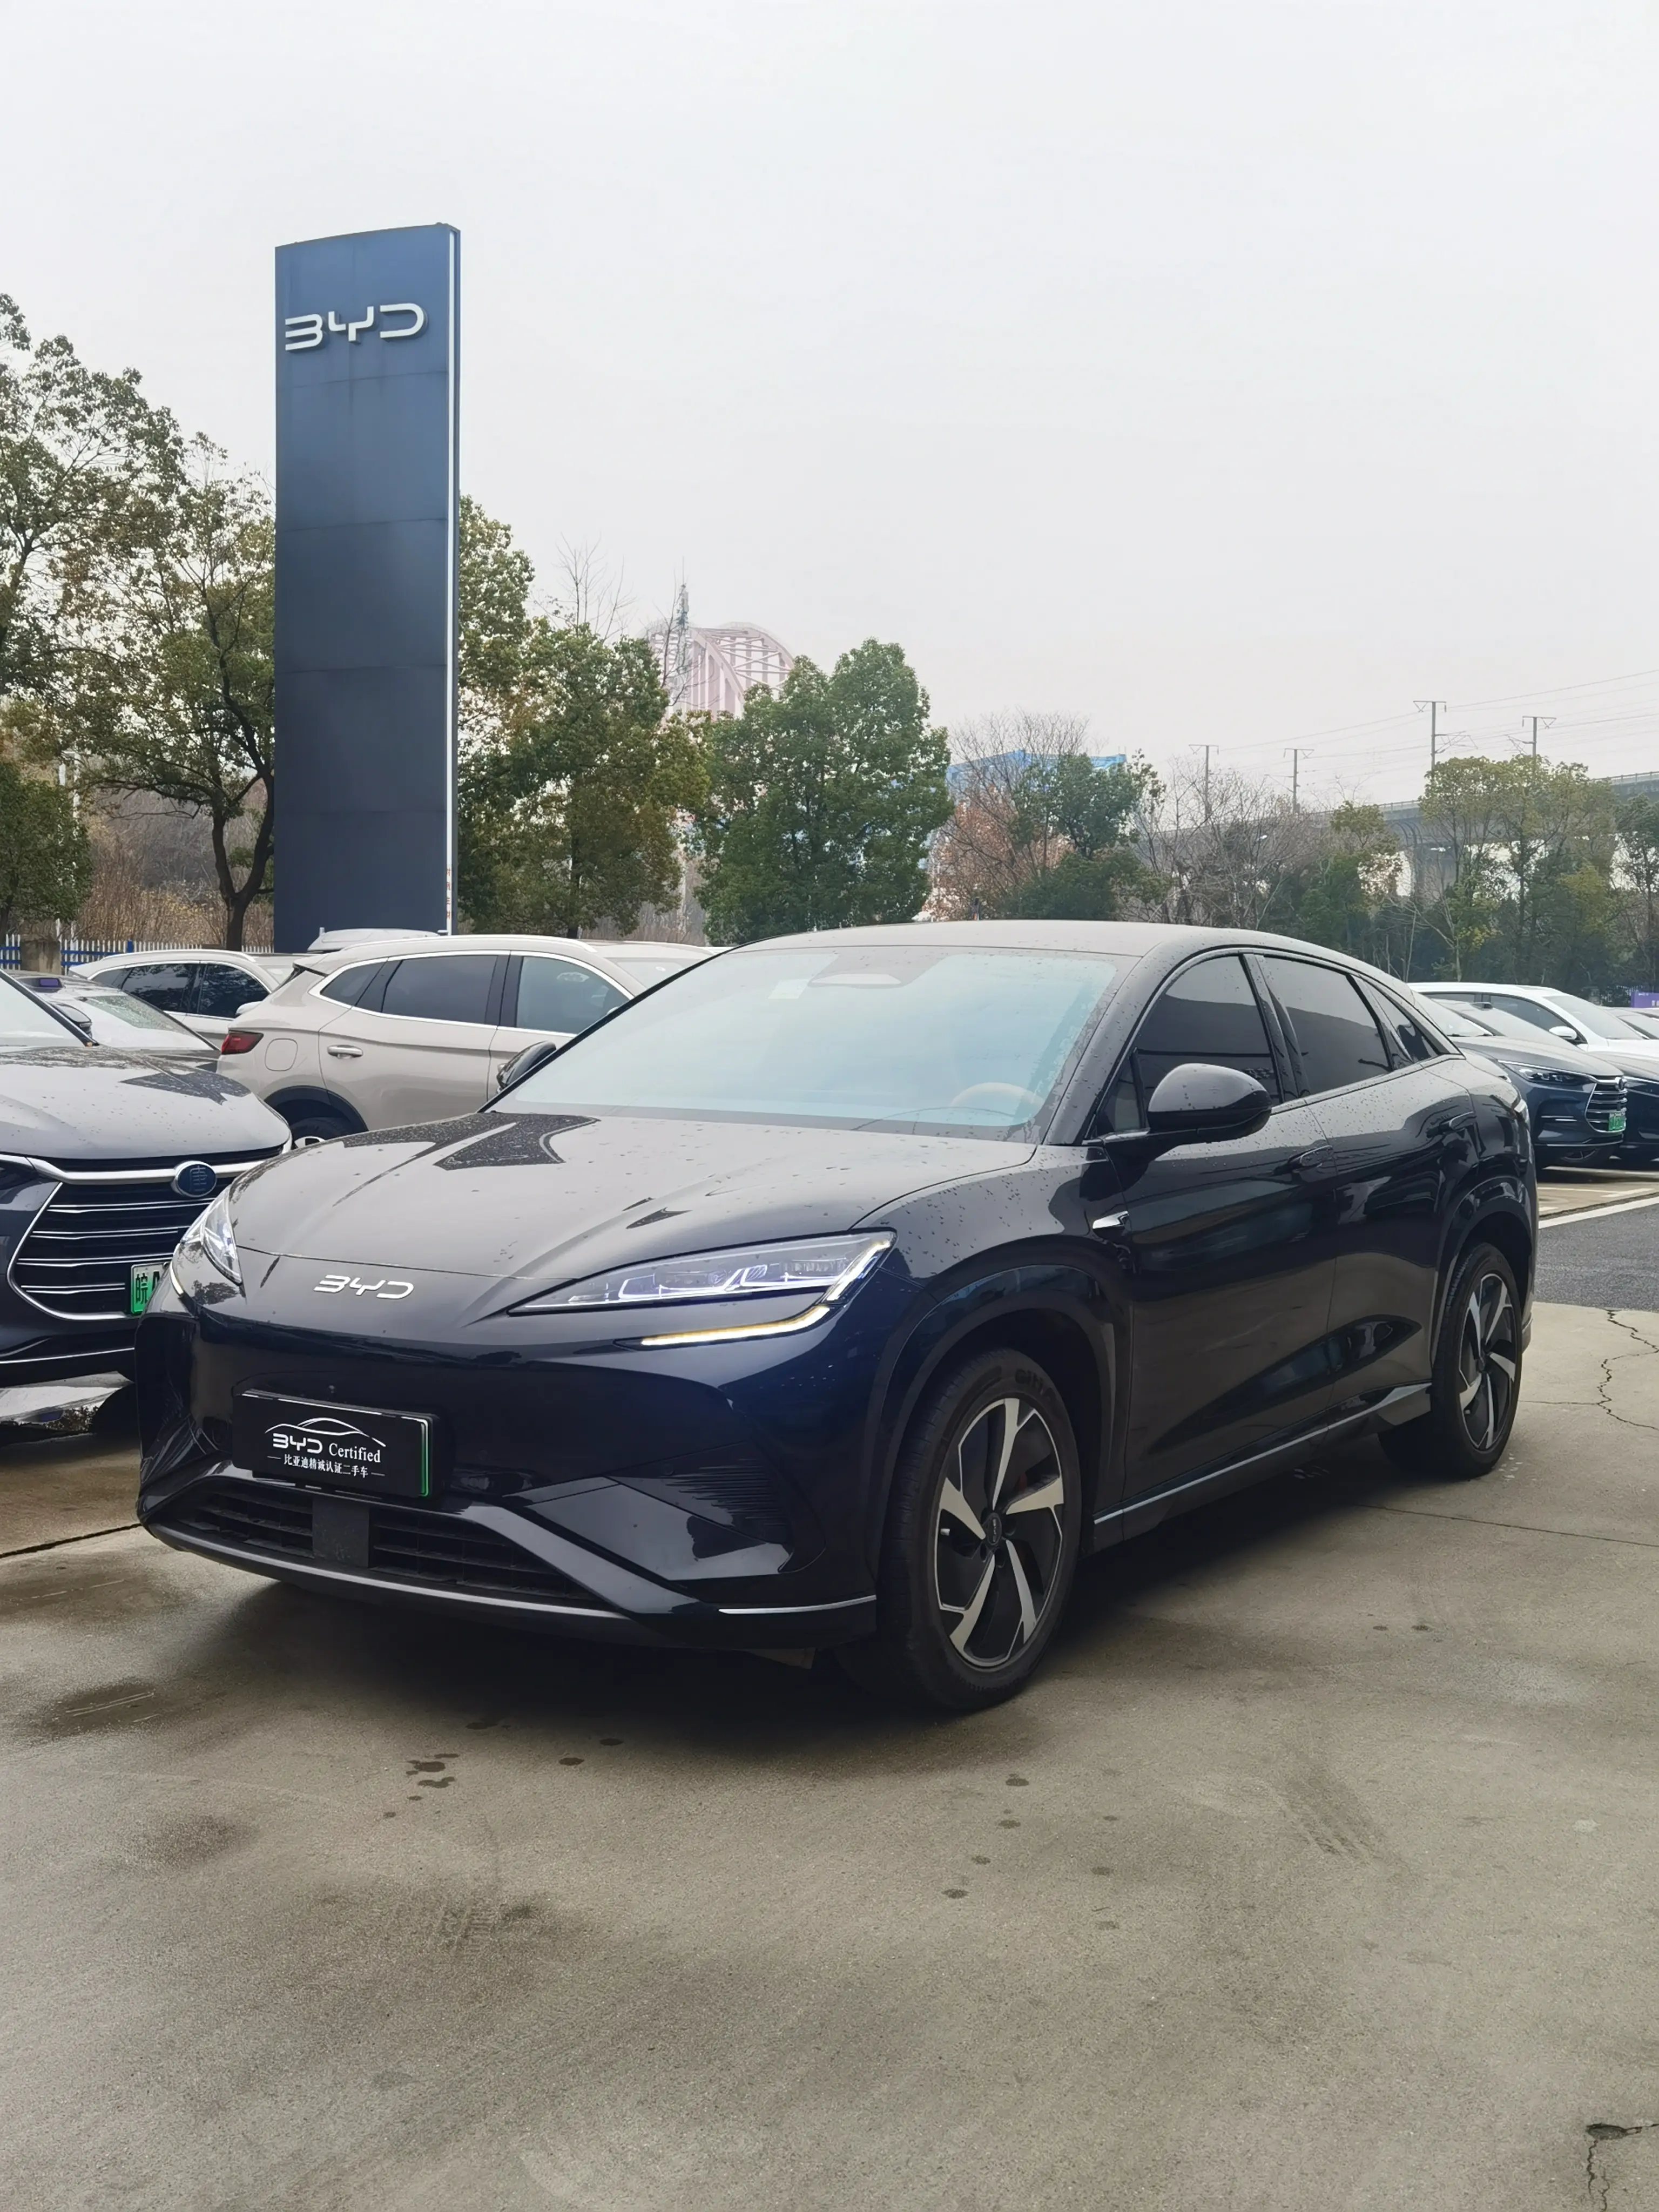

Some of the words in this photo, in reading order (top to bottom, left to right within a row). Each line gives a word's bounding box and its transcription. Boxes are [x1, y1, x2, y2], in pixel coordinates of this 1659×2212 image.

[285, 302, 425, 351] BYD
[313, 1274, 414, 1299] BYD
[273, 1433, 323, 1454] BYD
[328, 1442, 381, 1463] Certified
[283, 1453, 369, 1478] 比亚迪精诚认证二手车
